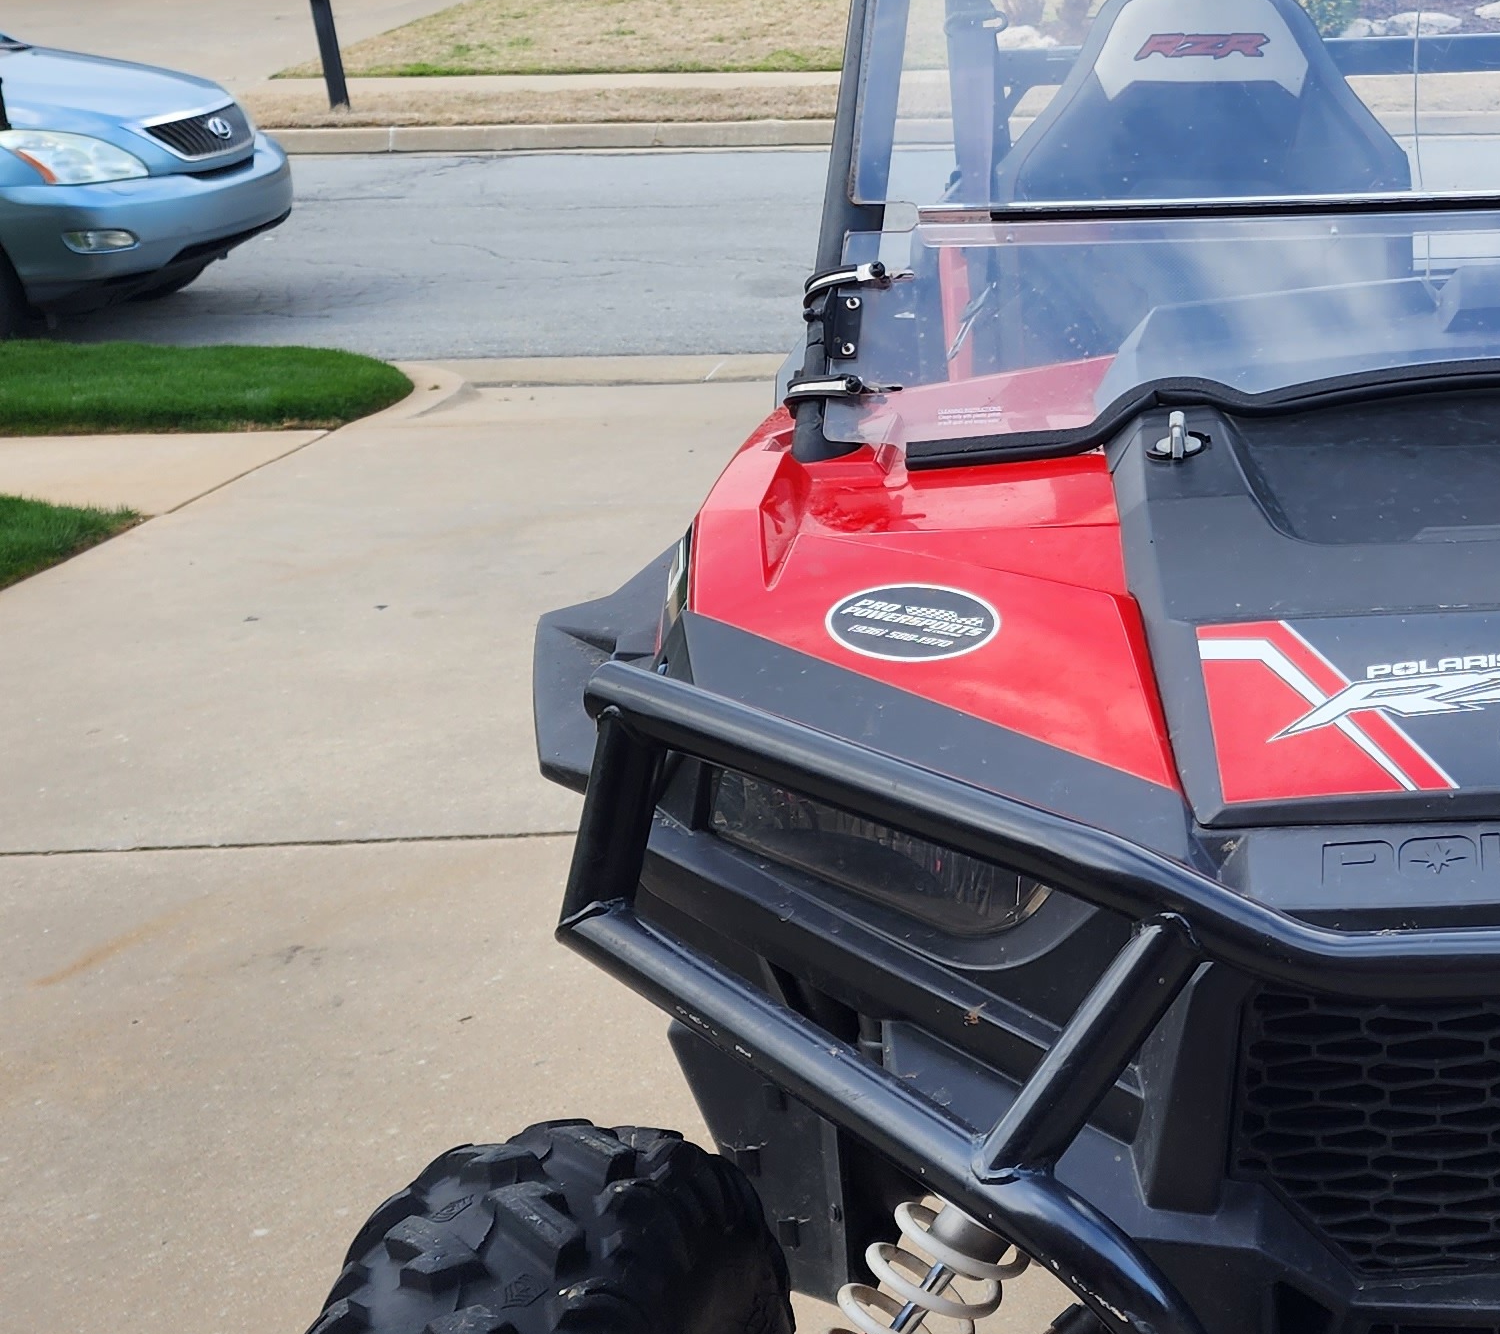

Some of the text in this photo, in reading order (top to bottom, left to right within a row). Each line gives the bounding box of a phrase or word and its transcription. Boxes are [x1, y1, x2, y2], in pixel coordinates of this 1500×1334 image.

[1134, 32, 1271, 61] RZR
[854, 598, 902, 613] PRO
[840, 605, 987, 637] POWERSPORTS
